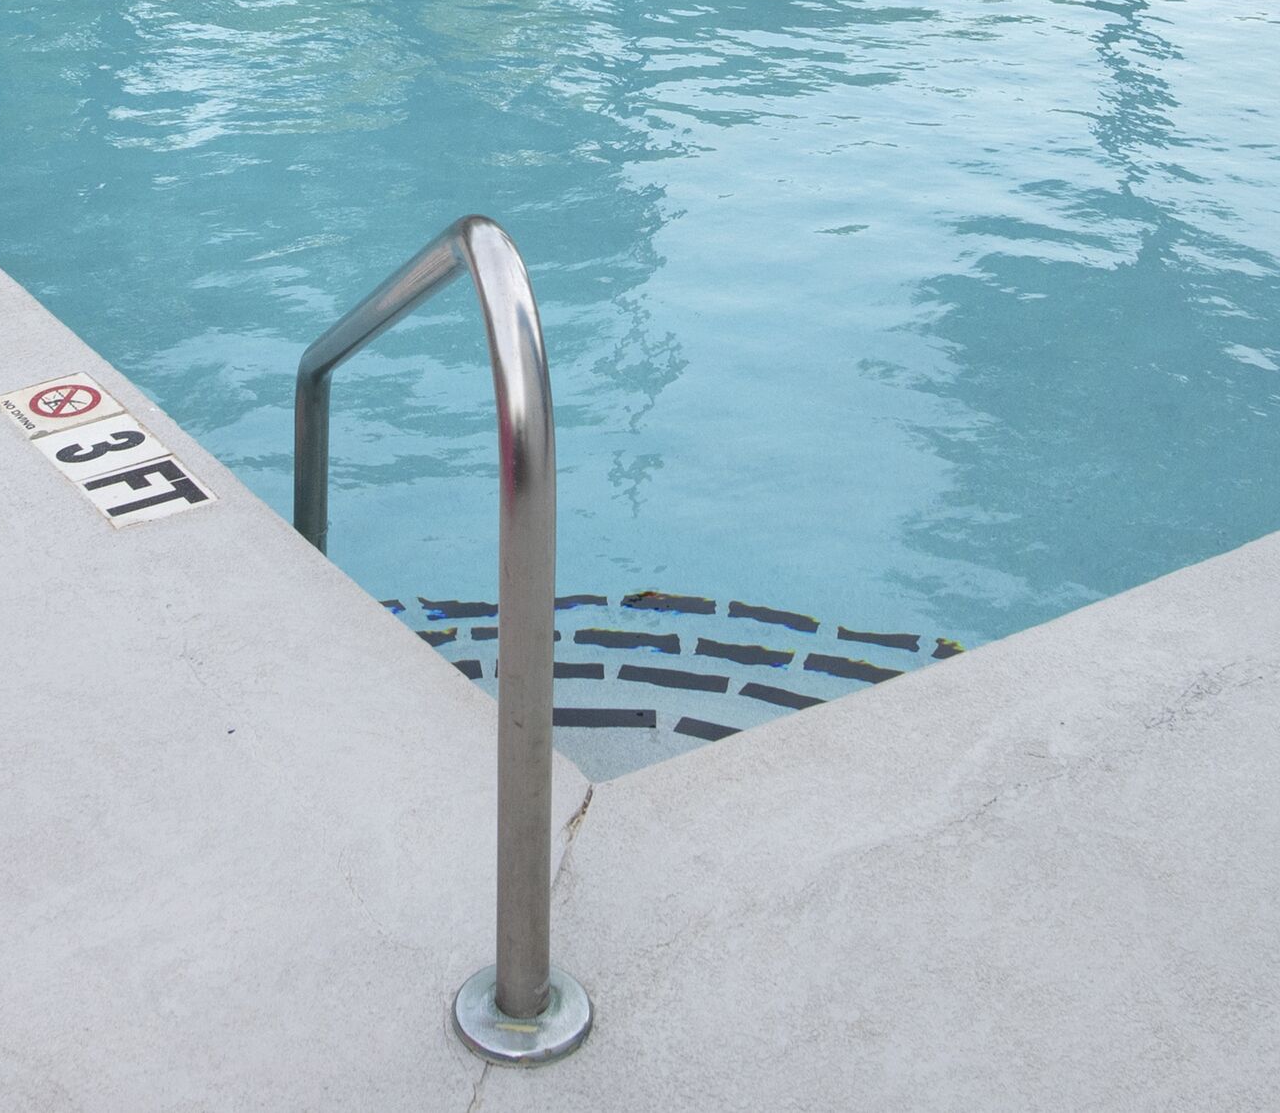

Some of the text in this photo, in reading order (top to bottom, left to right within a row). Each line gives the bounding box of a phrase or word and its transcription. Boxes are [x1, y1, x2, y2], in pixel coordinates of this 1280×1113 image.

[1, 400, 36, 430] NO DIVING
[55, 430, 209, 518] 3 FT
